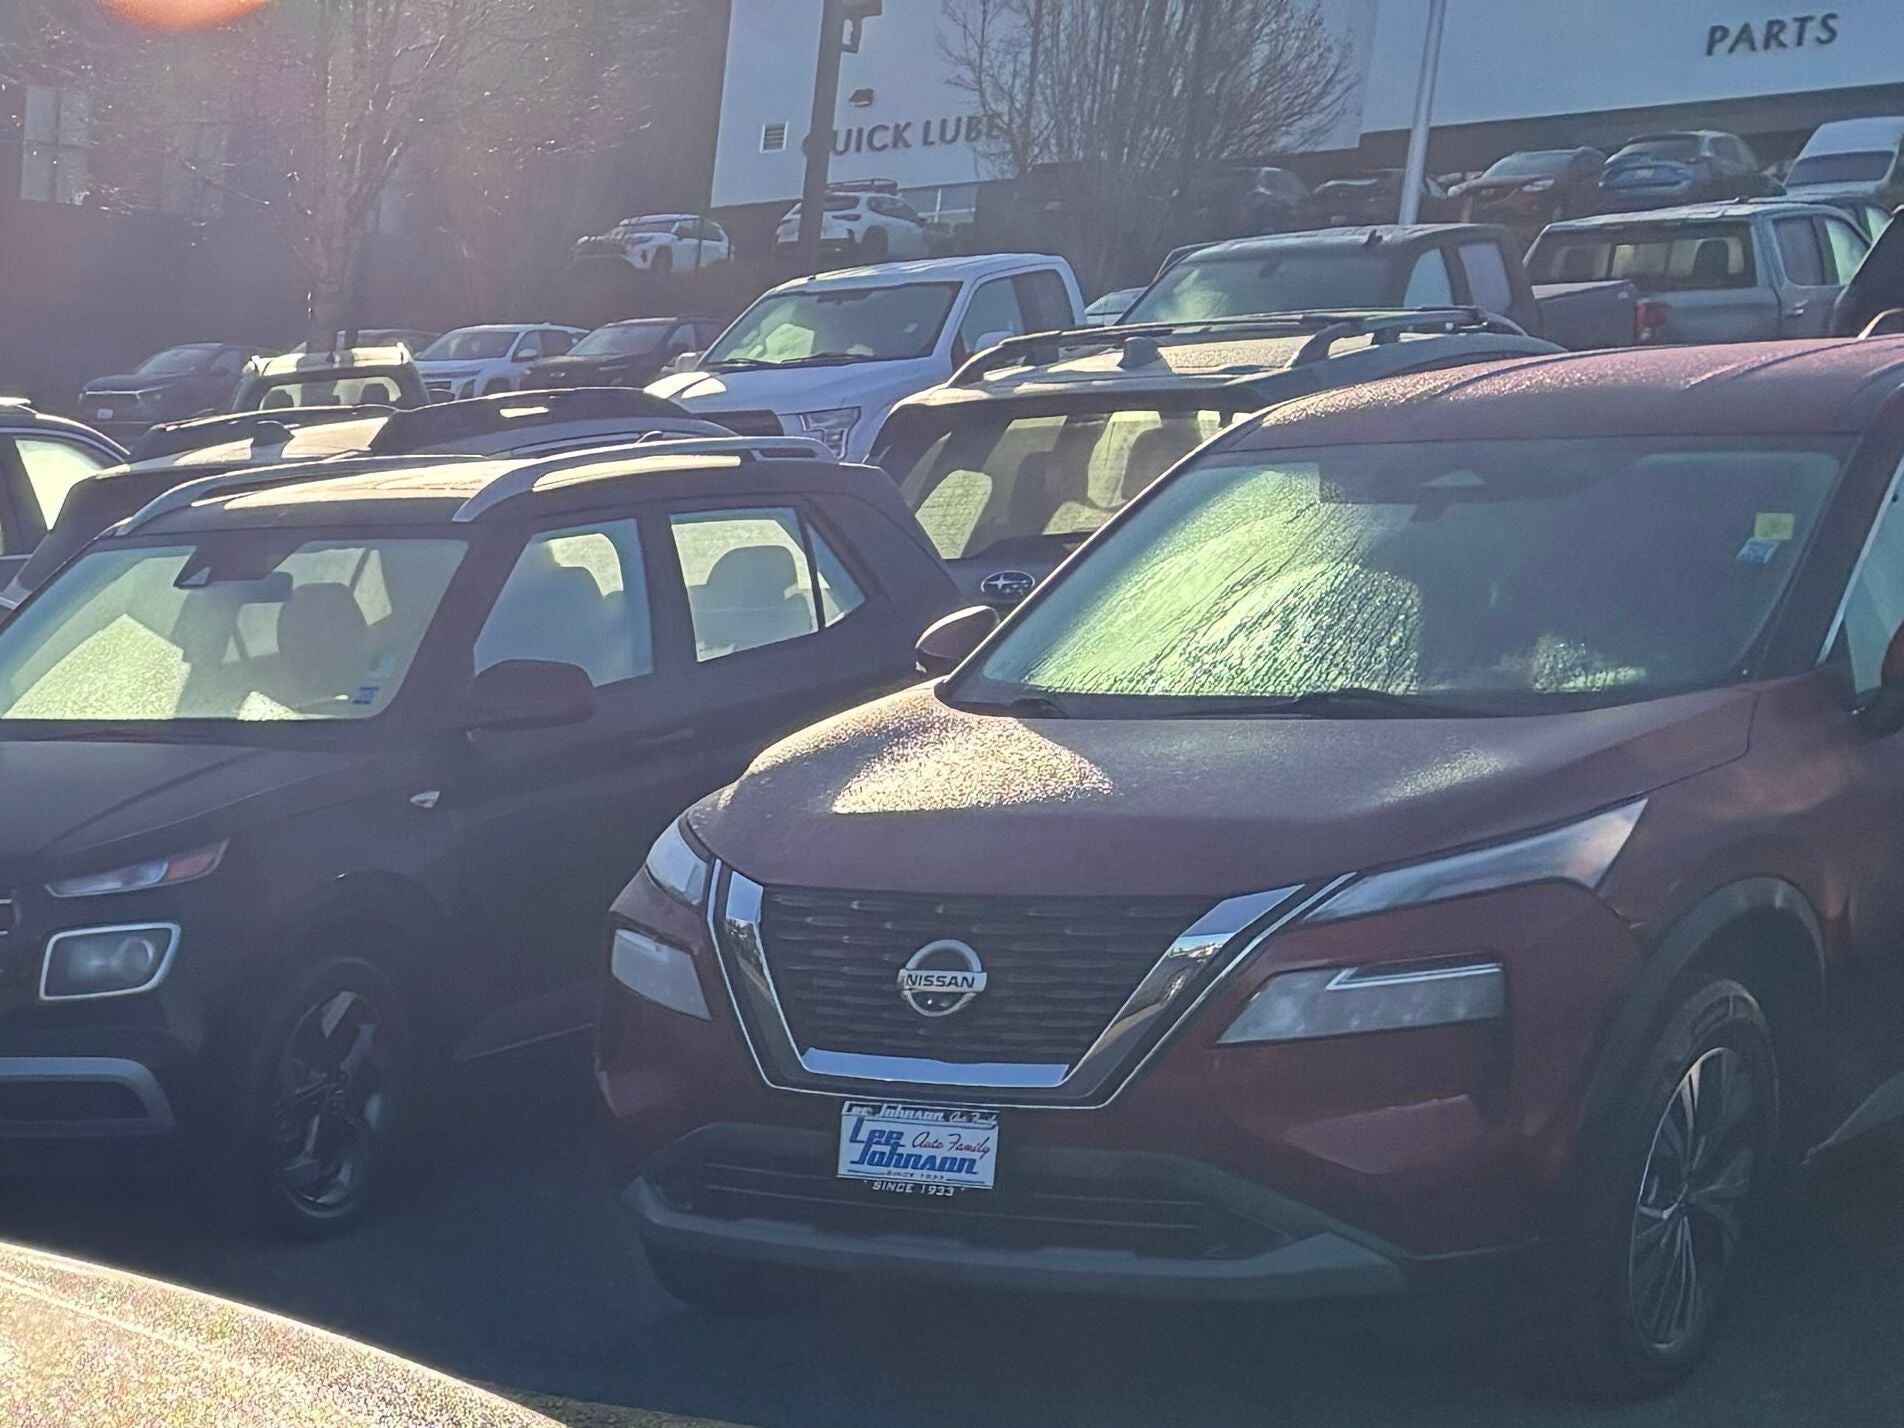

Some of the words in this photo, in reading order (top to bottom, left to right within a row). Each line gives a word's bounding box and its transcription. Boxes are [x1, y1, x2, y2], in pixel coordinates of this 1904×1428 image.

[1706, 12, 1838, 56] PARTS
[801, 121, 912, 157] UICK
[905, 973, 975, 989] NISSAN
[849, 1116, 905, 1147] Lee
[912, 1131, 944, 1149] Auto
[947, 1133, 990, 1160] Family
[850, 1142, 978, 1175] Johnson
[872, 1180, 913, 1193] SINCE
[920, 1182, 955, 1197] 1933
